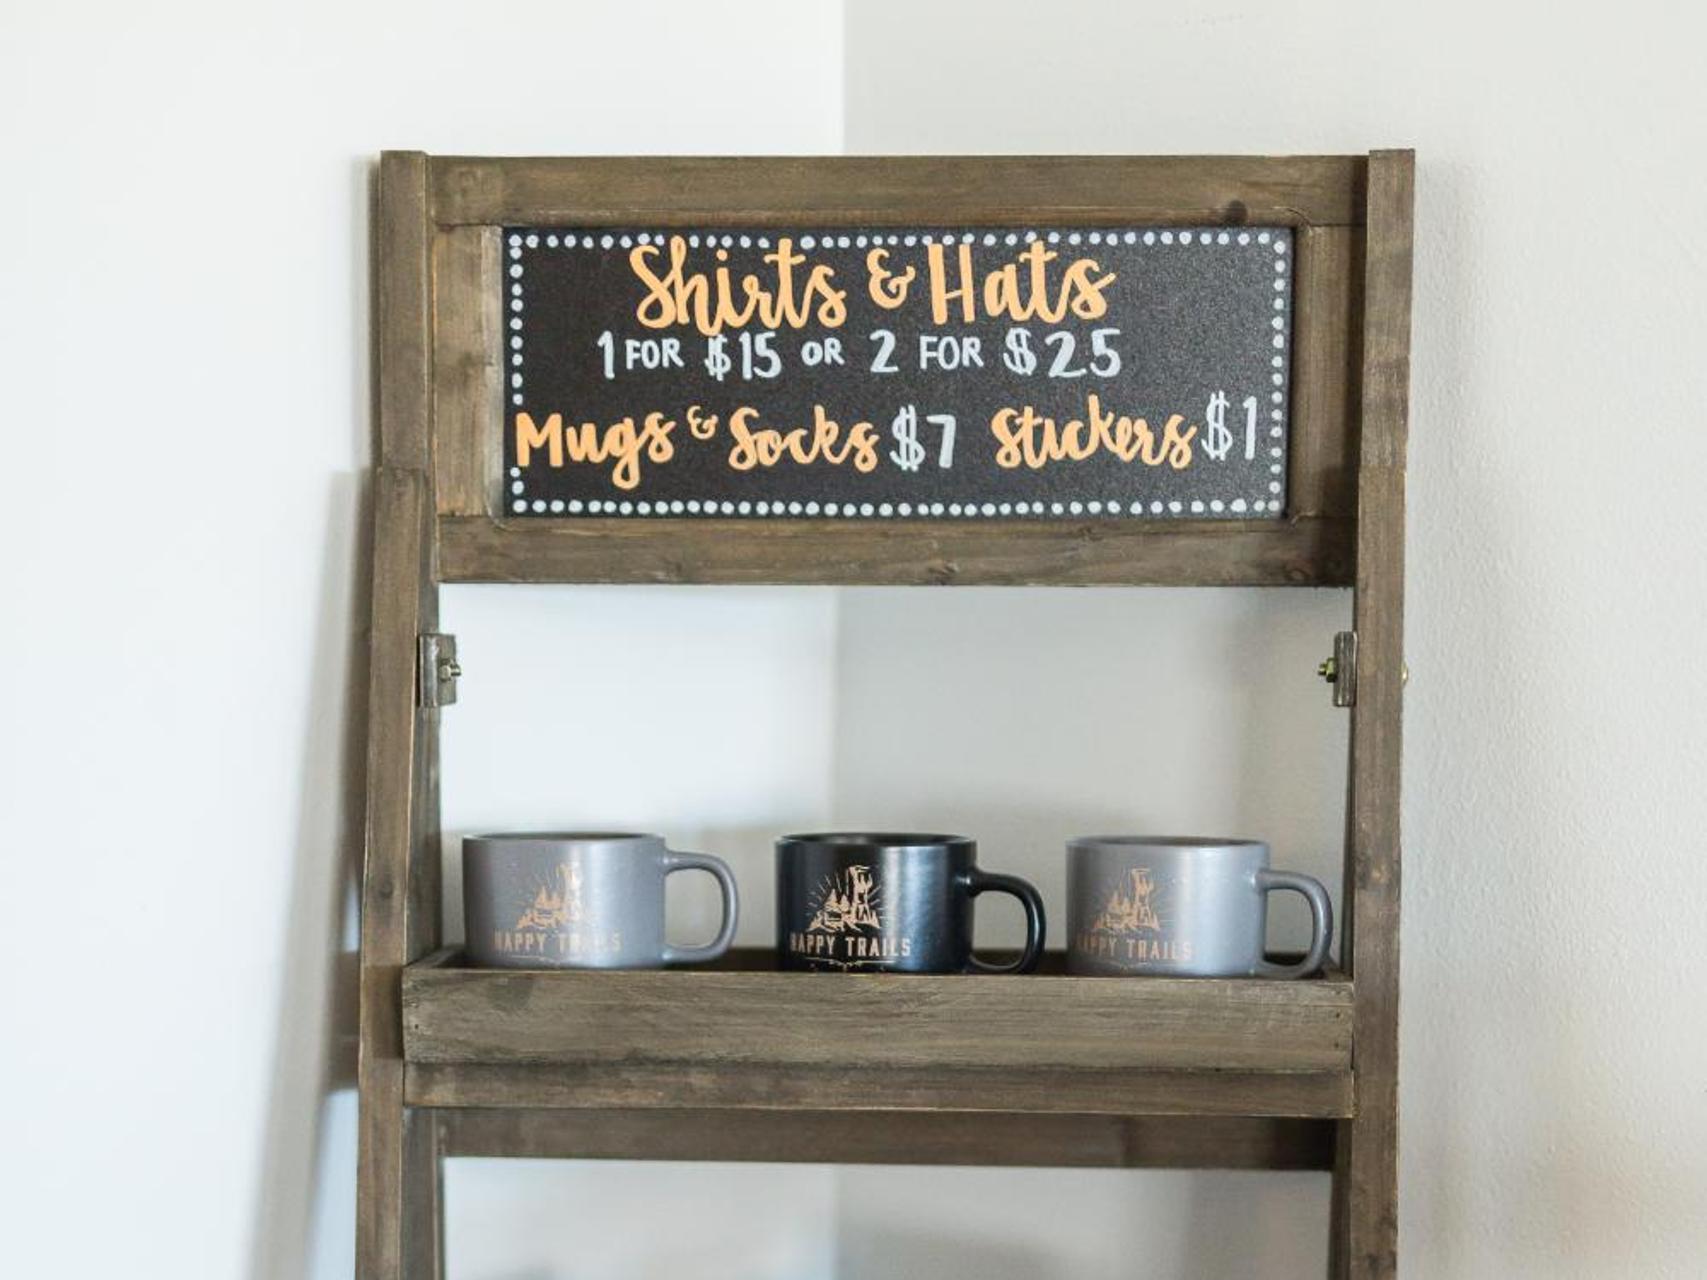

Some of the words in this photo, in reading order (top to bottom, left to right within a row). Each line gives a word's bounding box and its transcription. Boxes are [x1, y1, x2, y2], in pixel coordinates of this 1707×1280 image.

[629, 235, 847, 336] Shirts
[866, 247, 917, 310] &
[927, 240, 1118, 325] Hats
[597, 330, 616, 380] 1
[625, 337, 685, 370] FOR
[704, 330, 782, 381] $15
[801, 336, 846, 366] OR
[869, 328, 899, 373] 2
[919, 335, 984, 371] FOR
[1003, 327, 1122, 378] $25
[515, 411, 677, 490] Mugs
[686, 405, 719, 439] &
[727, 404, 881, 473] Socks
[889, 404, 957, 472] $7
[990, 393, 1198, 470] Stickers
[1201, 390, 1258, 461] $1
[493, 928, 547, 952] HAPPY
[790, 932, 835, 955] HAPPY
[844, 936, 911, 957] TRAILS
[1126, 938, 1192, 961] TRAILS
